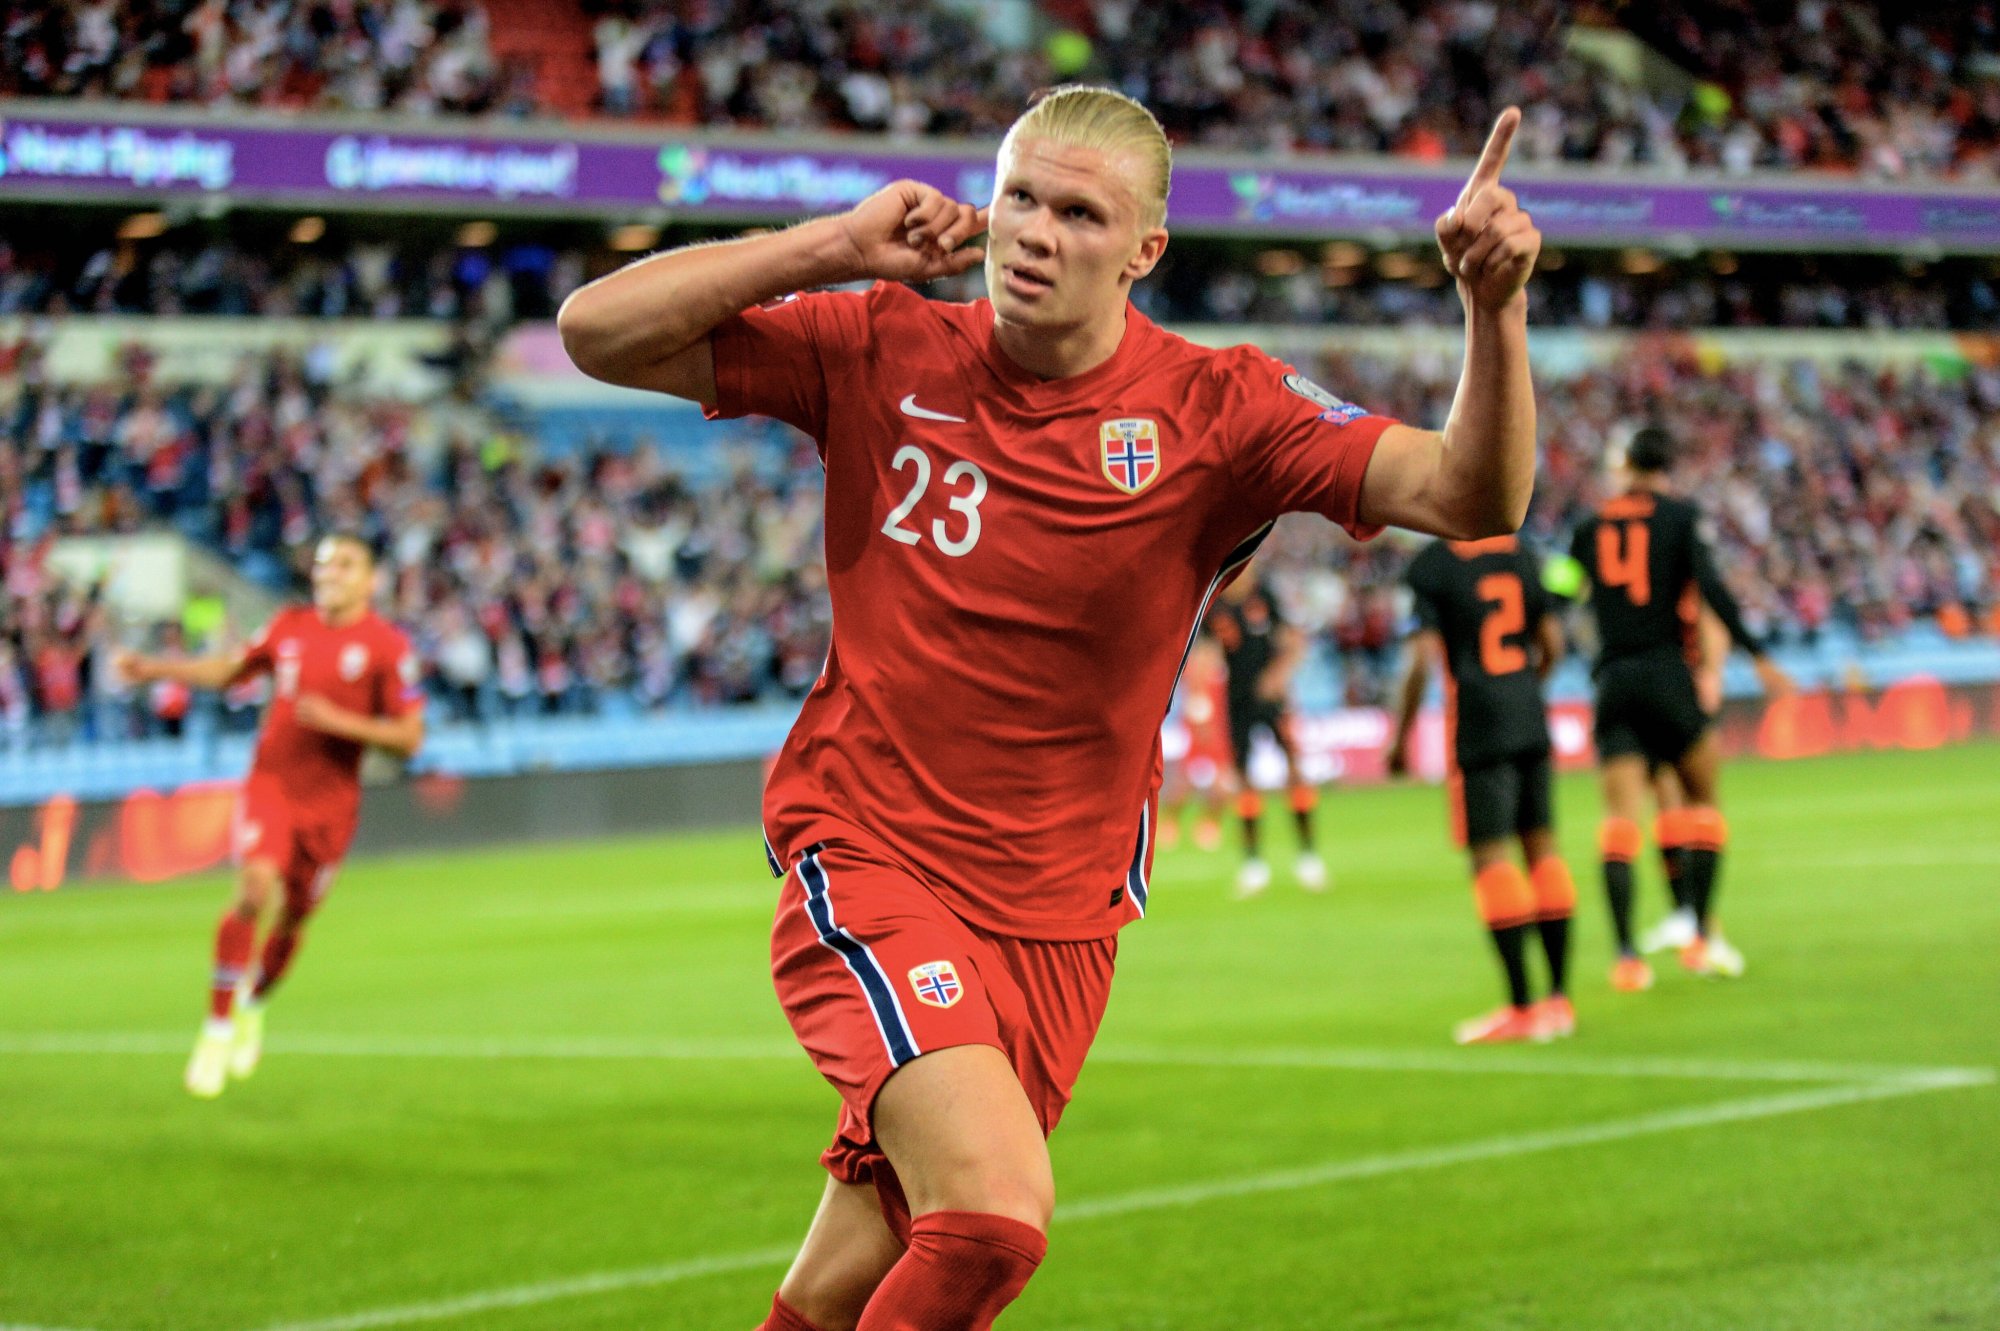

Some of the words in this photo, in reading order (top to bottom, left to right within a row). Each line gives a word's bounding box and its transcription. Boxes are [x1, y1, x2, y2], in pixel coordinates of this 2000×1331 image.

[880, 445, 988, 557] 23
[1597, 520, 1652, 606] 4
[1476, 573, 1528, 676] 2
